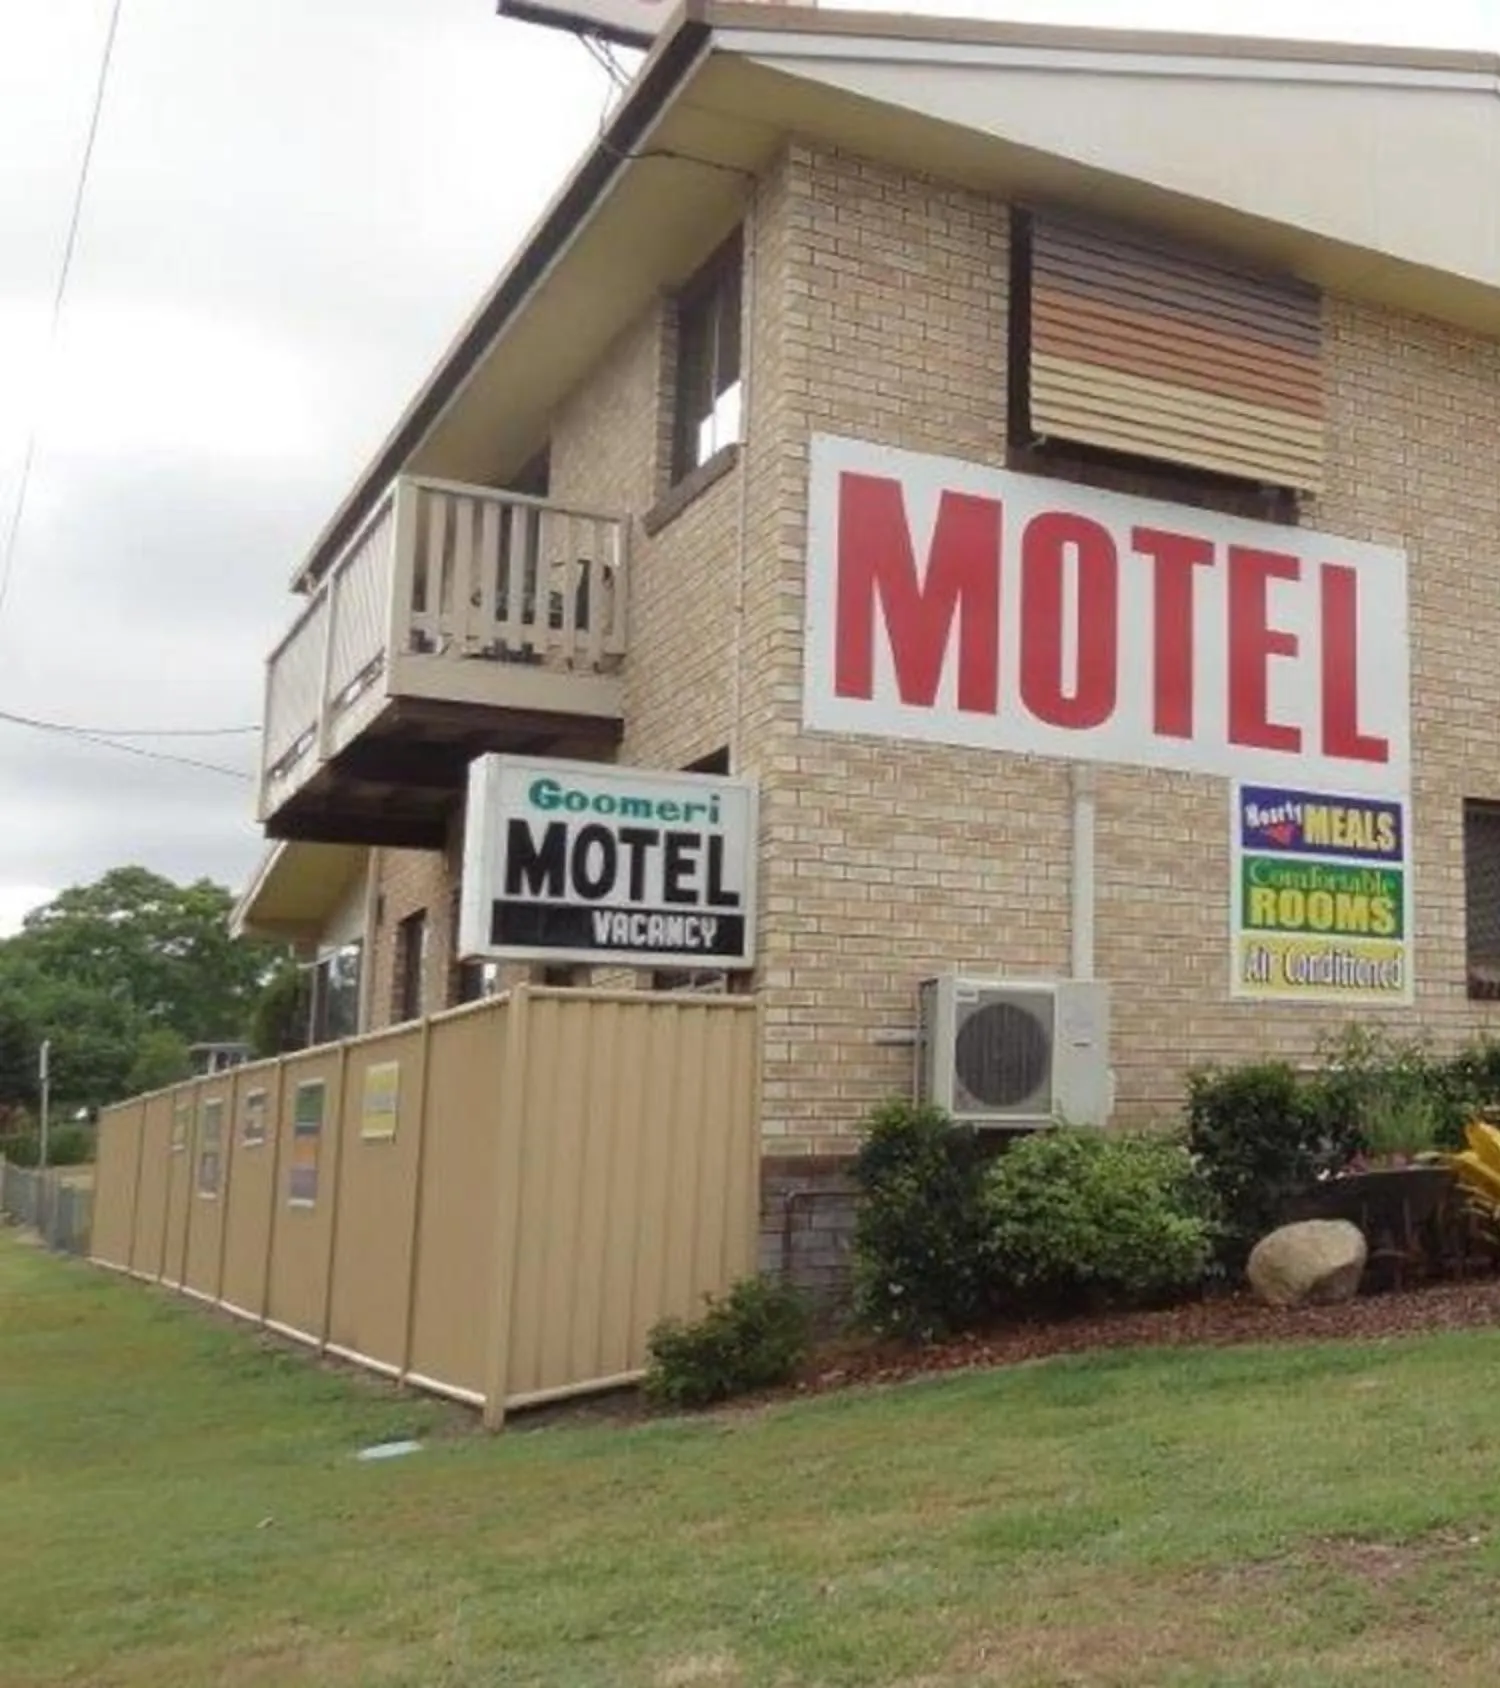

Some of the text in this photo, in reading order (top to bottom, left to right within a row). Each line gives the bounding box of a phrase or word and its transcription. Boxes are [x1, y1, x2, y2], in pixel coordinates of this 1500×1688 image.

[834, 471, 1390, 764] MOTEL
[528, 777, 721, 825] Goomeri
[1303, 803, 1396, 851] MEALS
[504, 818, 740, 907] MOTEL
[592, 910, 717, 948] VACANCY
[1250, 886, 1396, 934] ROOMS
